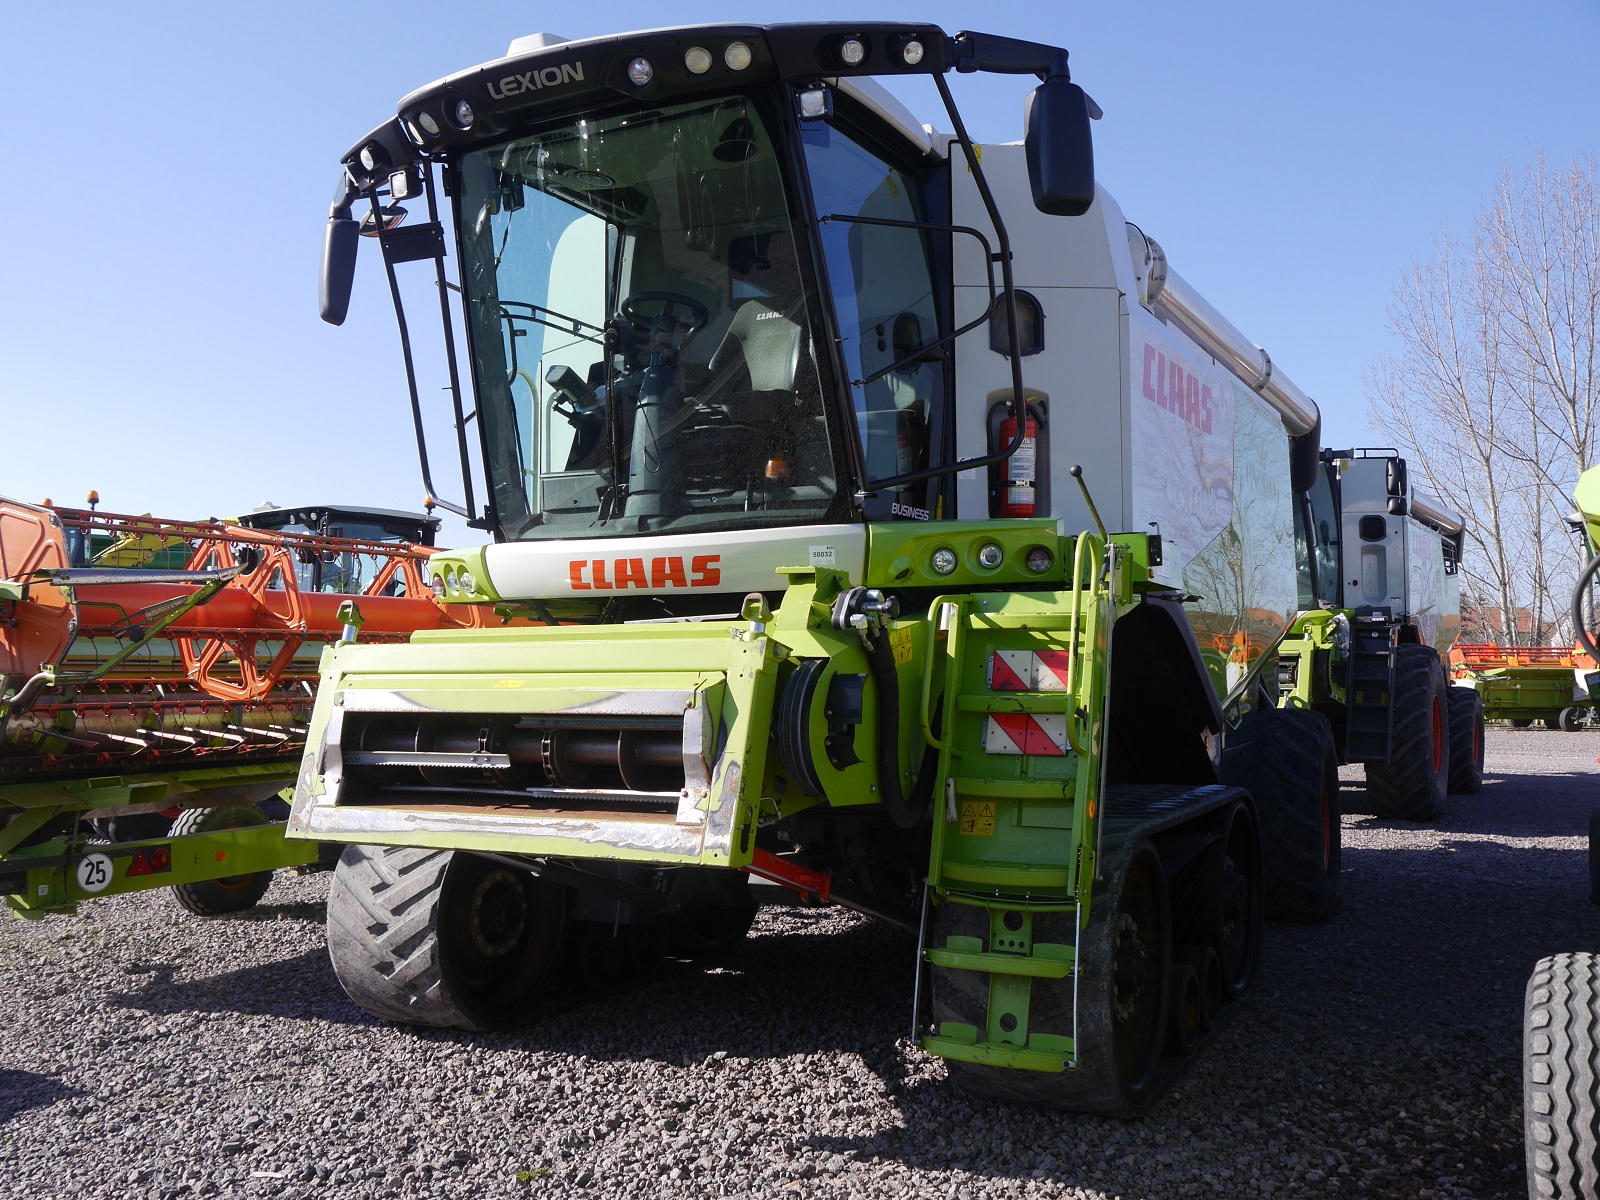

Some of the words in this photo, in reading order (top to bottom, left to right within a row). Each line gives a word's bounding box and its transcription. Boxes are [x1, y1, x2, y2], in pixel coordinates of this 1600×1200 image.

[486, 61, 585, 100] LEXION
[1142, 342, 1213, 436] CLAAS
[891, 502, 930, 521] BUSINESS
[812, 550, 833, 558] 58032
[569, 554, 721, 590] CLAAS
[84, 860, 106, 885] 25
